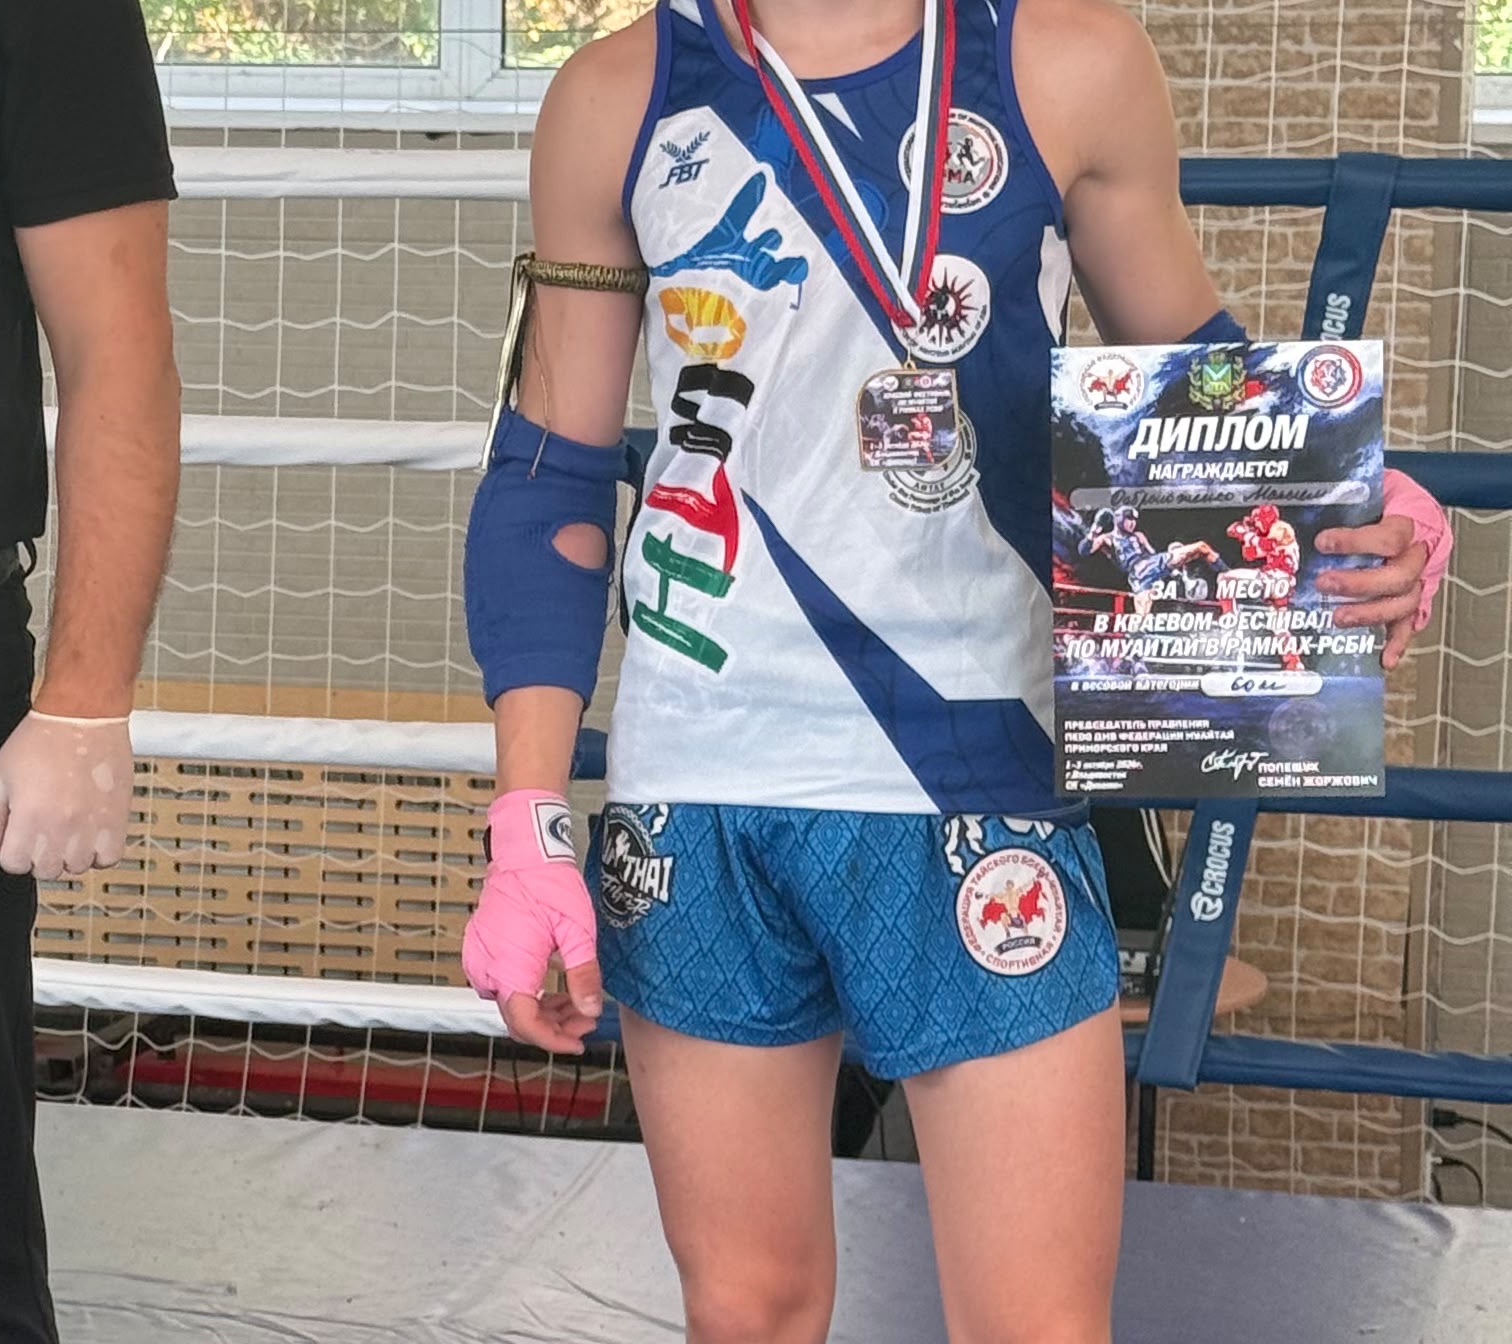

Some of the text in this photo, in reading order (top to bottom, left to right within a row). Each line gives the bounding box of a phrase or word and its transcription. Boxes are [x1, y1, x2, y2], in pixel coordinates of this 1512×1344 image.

[658, 158, 710, 189] FBT
[1128, 414, 1309, 459] ДИПЛОМ
[1149, 460, 1289, 481] НАГРАЖДАЕТСЯ
[1151, 579, 1178, 600] ЗА
[1216, 578, 1290, 599] МЕСТО
[1093, 613, 1110, 633] В
[1218, 610, 1335, 631] ФЕСТИВАЛ
[1066, 639, 1097, 658] ПО
[1205, 637, 1220, 655] В
[1064, 719, 1210, 730] ПРЕДСЕДАТЕЛЬ ПРАВЛЕНИЯ
[1064, 742, 1169, 754] ПРИМОРСКОГО КРАЯ
[1257, 774, 1379, 788] СЕМЁН ЖОРЖОВИЧ
[1200, 819, 1236, 897] CROCUS
[1001, 937, 1036, 951] РОССИЯ
[986, 942, 1055, 970] СПОРТИВНАЯ
